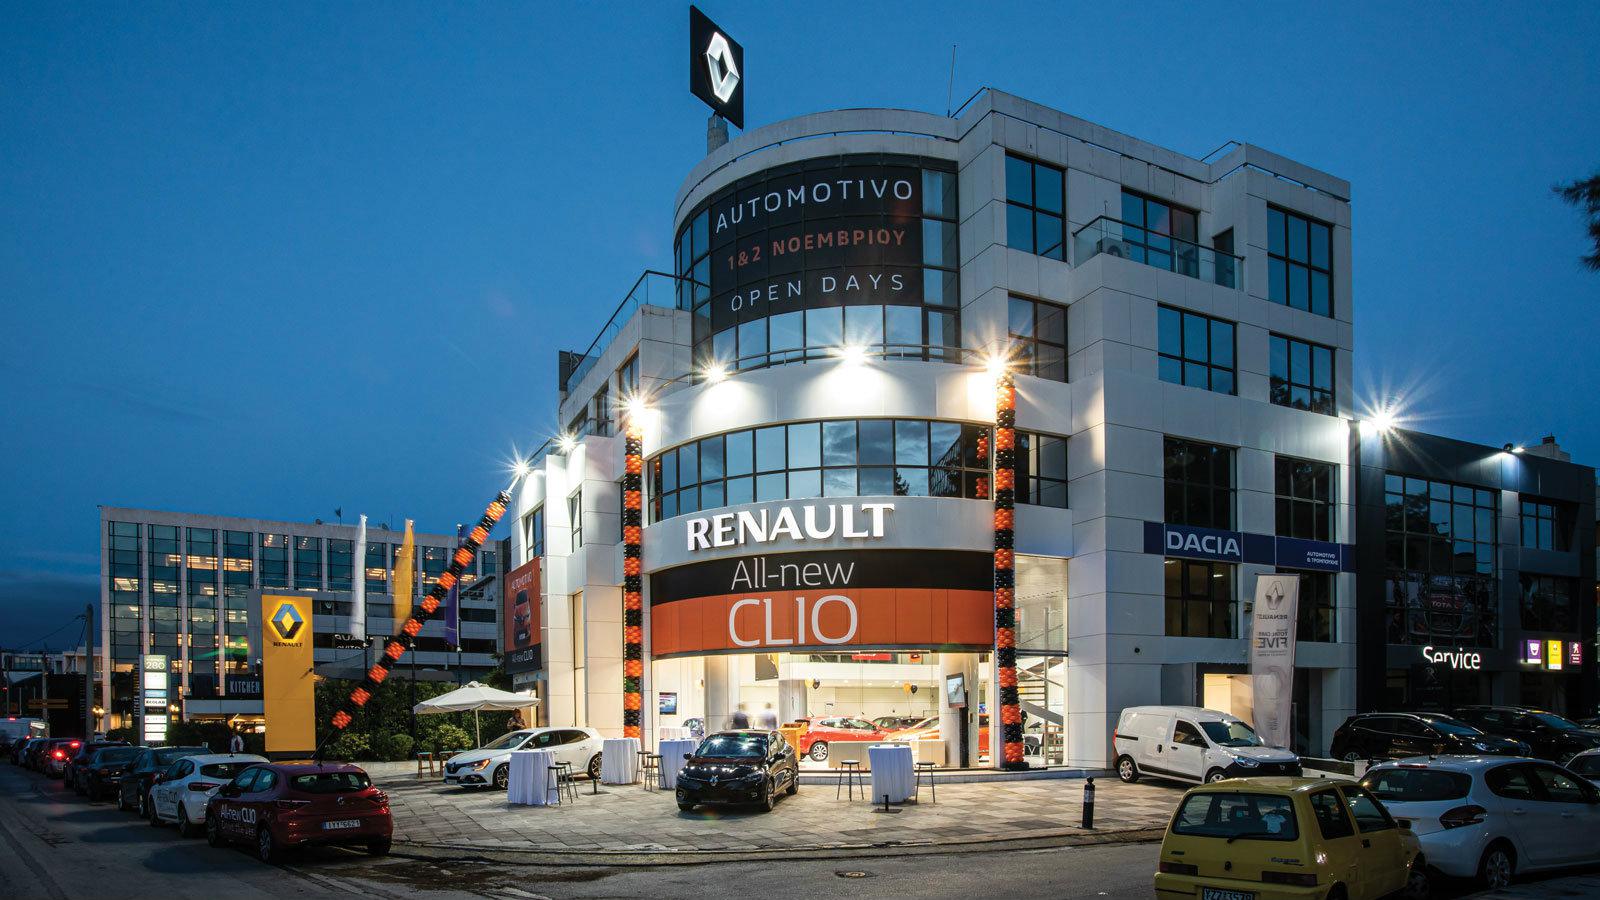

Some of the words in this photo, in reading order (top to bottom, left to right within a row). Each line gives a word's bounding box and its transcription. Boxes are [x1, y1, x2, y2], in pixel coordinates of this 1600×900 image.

[716, 179, 913, 234] AUTOMOTIVO
[727, 245, 762, 271] 1&2
[772, 228, 906, 257] ΝΟΕΜΒΡΙΟΥ
[731, 279, 802, 312] OPEN
[821, 273, 904, 293] DAYS
[686, 503, 895, 551] RENAULT
[1166, 531, 1241, 556] DACIA
[731, 557, 855, 591] All-new
[728, 594, 858, 648] CLIO
[145, 661, 165, 670] 280
[1423, 645, 1481, 670] Service
[229, 680, 260, 694] KITCHEN
